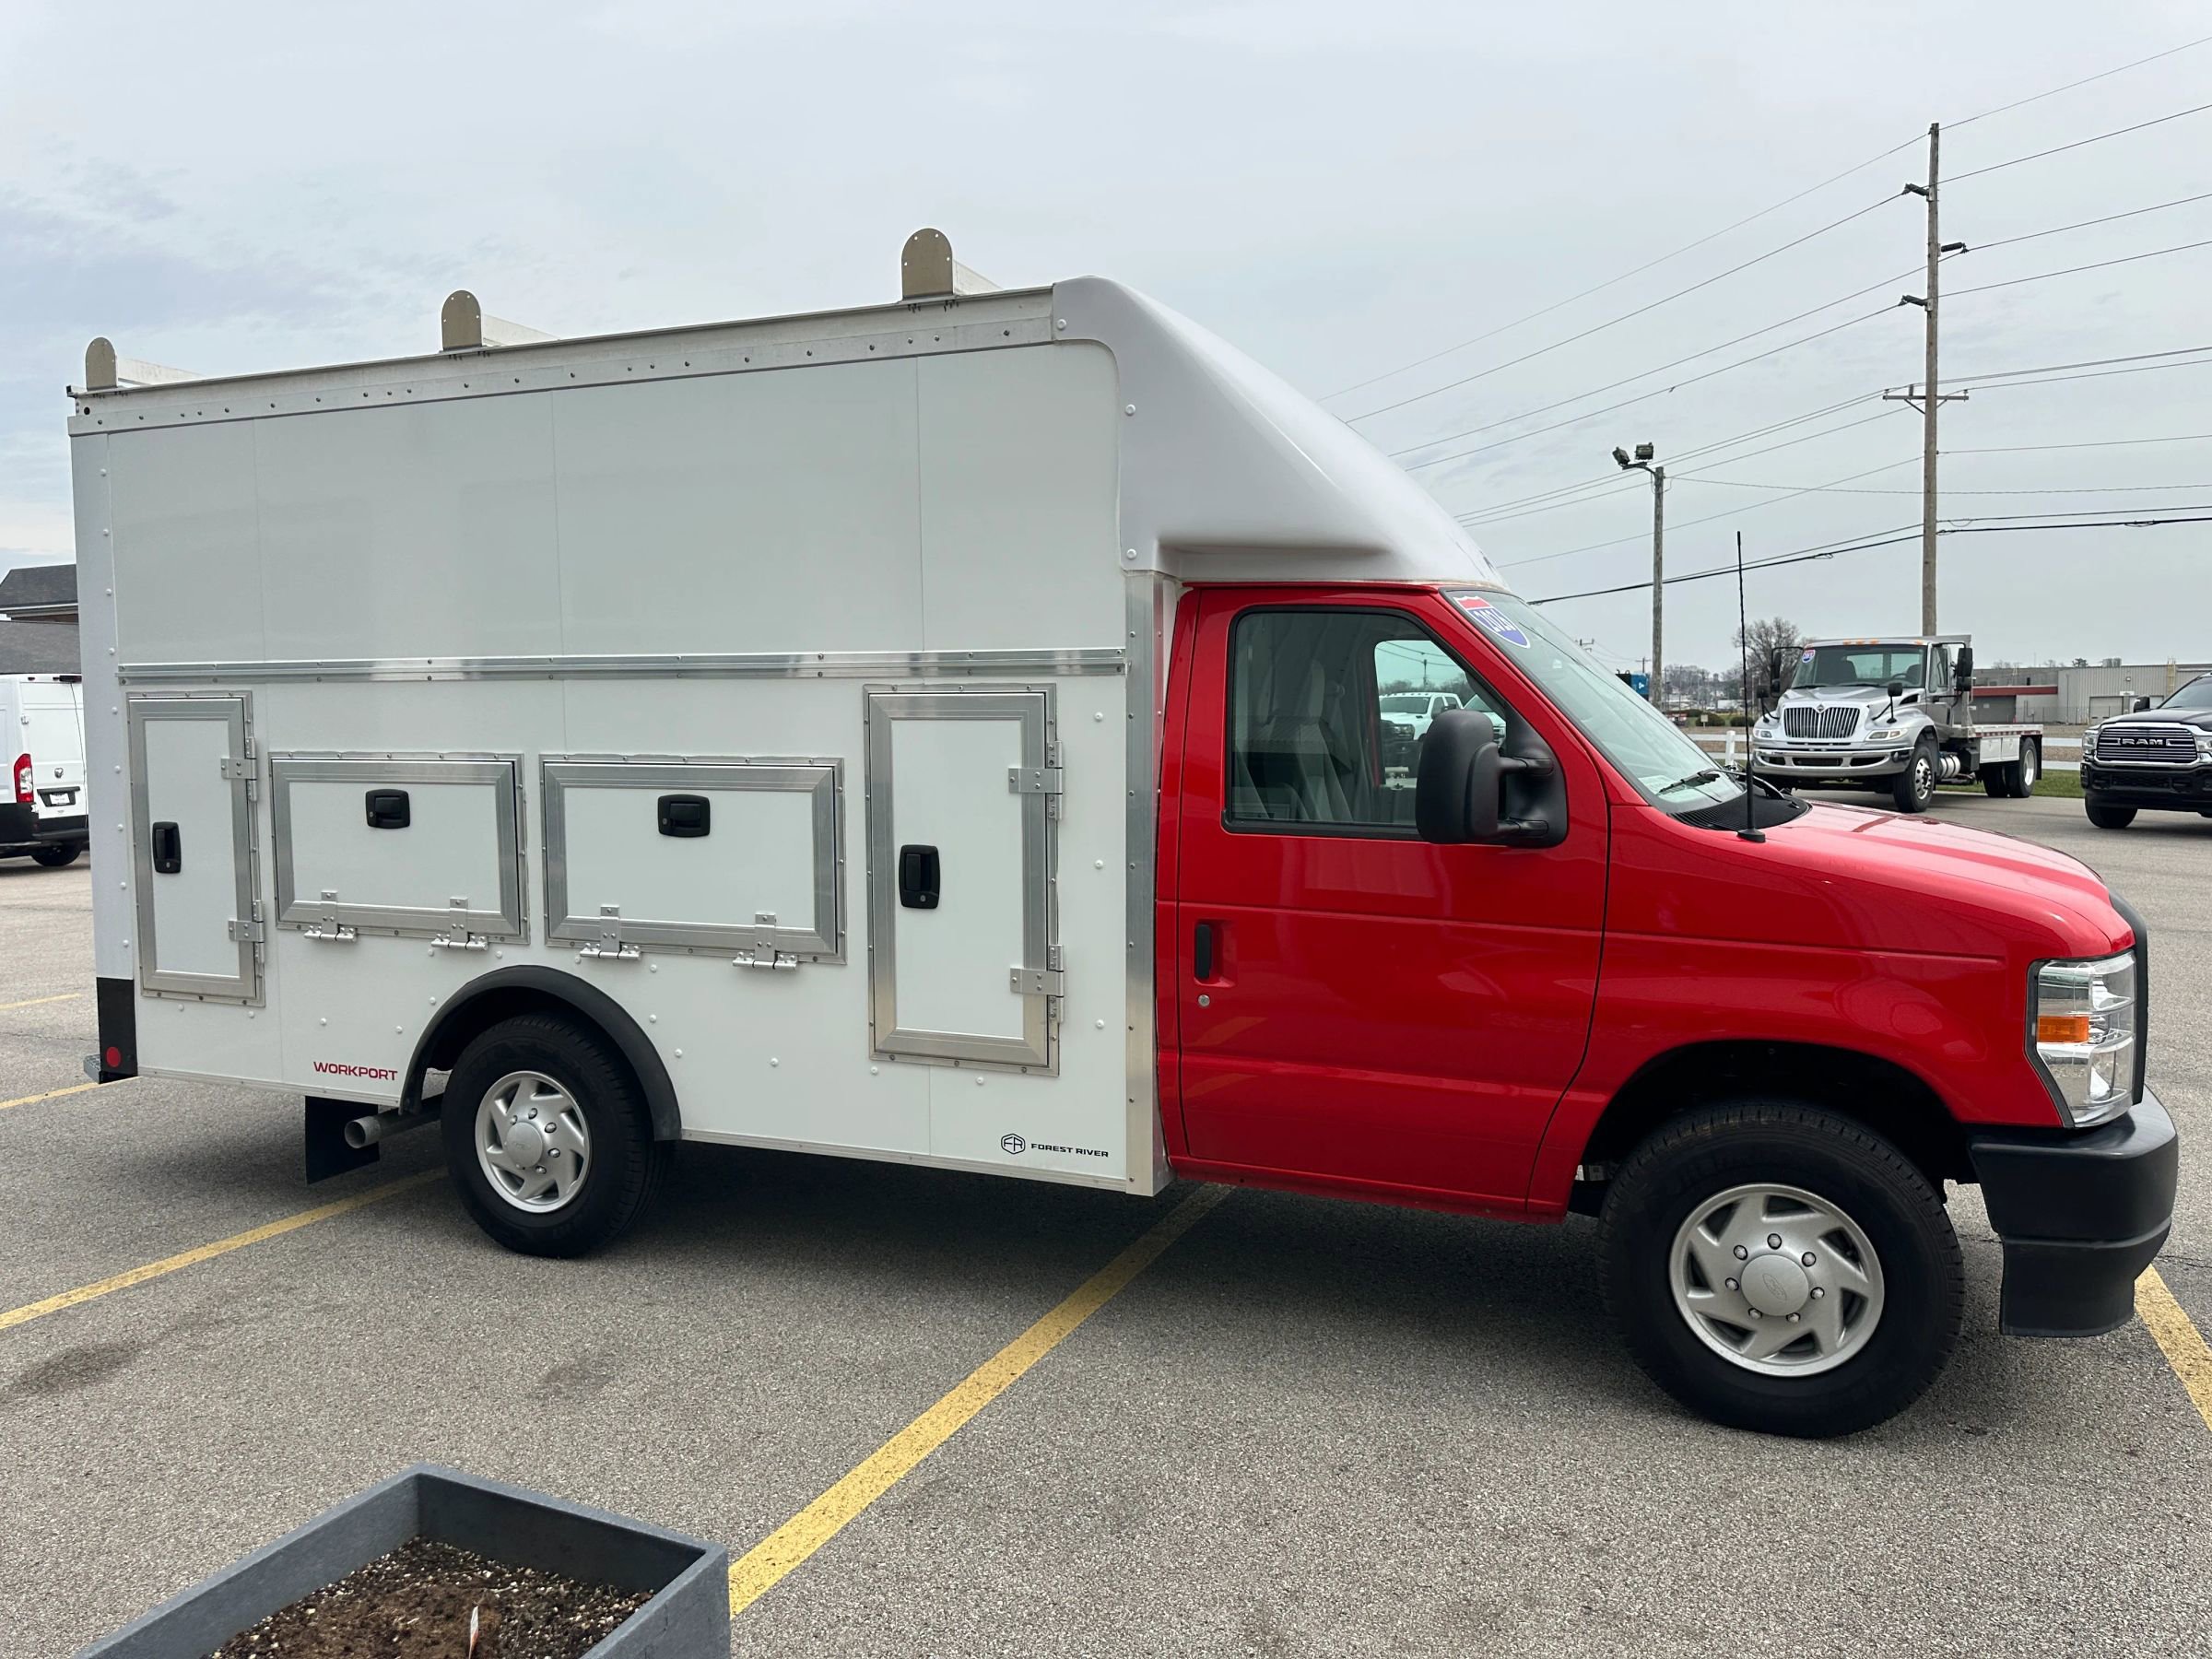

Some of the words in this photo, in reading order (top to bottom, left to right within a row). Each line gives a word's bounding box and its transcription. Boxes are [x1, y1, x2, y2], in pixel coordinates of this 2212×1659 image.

[313, 1061, 398, 1080] WORKPORT
[1030, 1143, 1074, 1153] FOREST
[1075, 1147, 1109, 1158] RIVER
